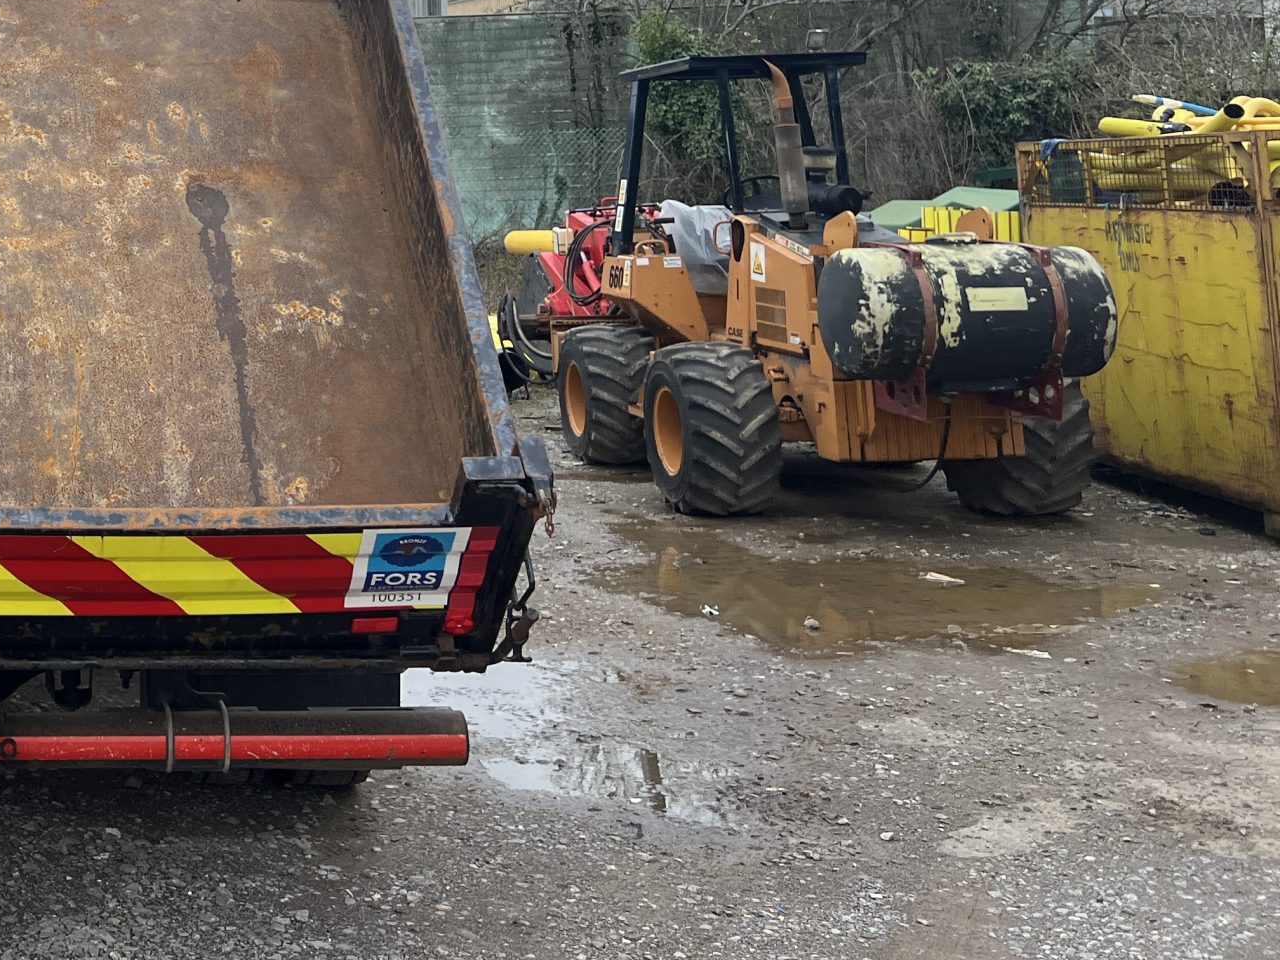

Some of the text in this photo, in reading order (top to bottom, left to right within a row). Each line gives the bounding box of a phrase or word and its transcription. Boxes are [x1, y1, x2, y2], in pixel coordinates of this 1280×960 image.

[1120, 251, 1140, 272] ONLY
[608, 265, 624, 289] 660
[727, 326, 744, 338] CASE
[370, 572, 437, 586] FORS
[371, 592, 422, 603] 100351
